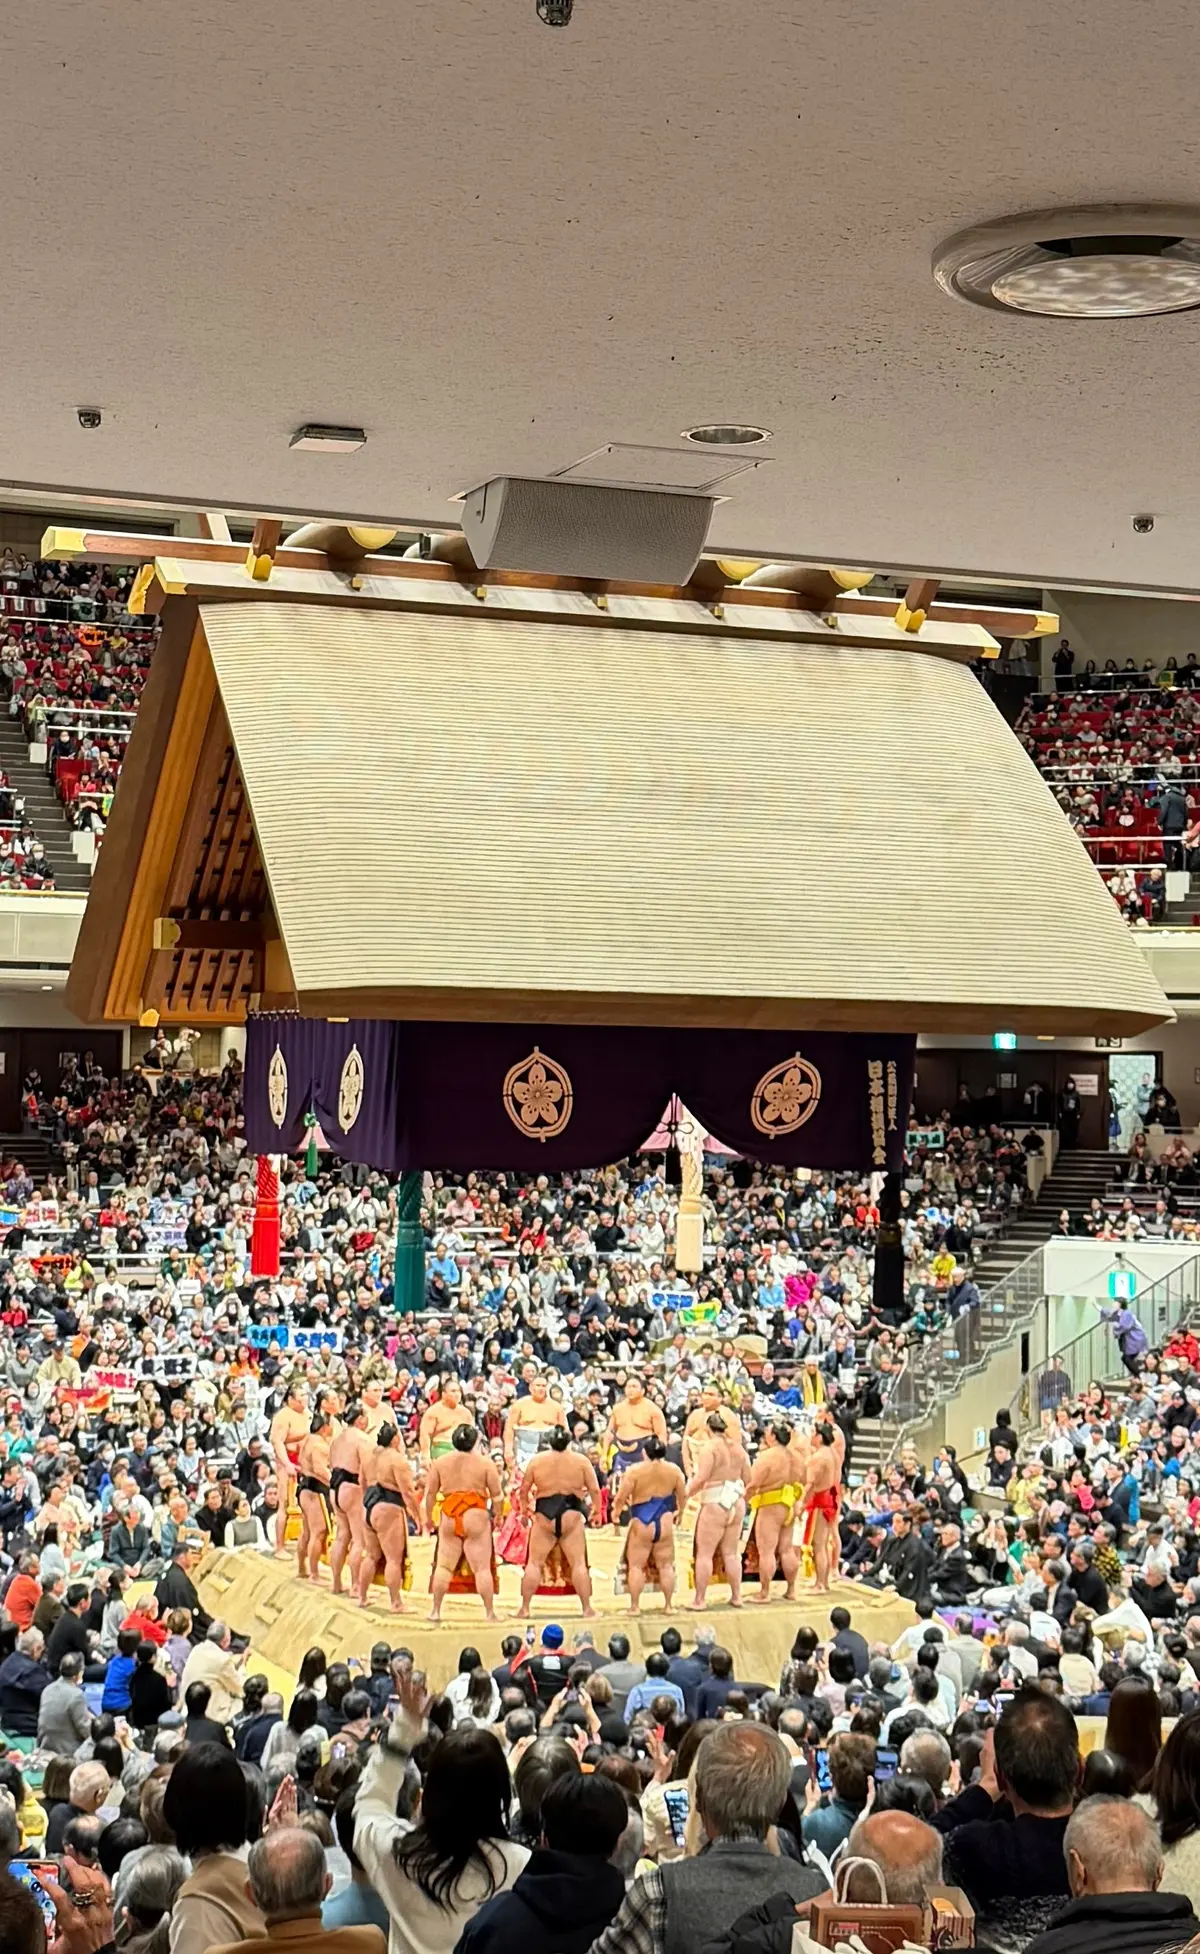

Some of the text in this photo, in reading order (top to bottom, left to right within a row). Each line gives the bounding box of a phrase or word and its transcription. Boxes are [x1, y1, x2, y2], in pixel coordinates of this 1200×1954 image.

[867, 1060, 887, 1165] 日本相撲協会
[887, 1061, 898, 1131] 公益財団法人
